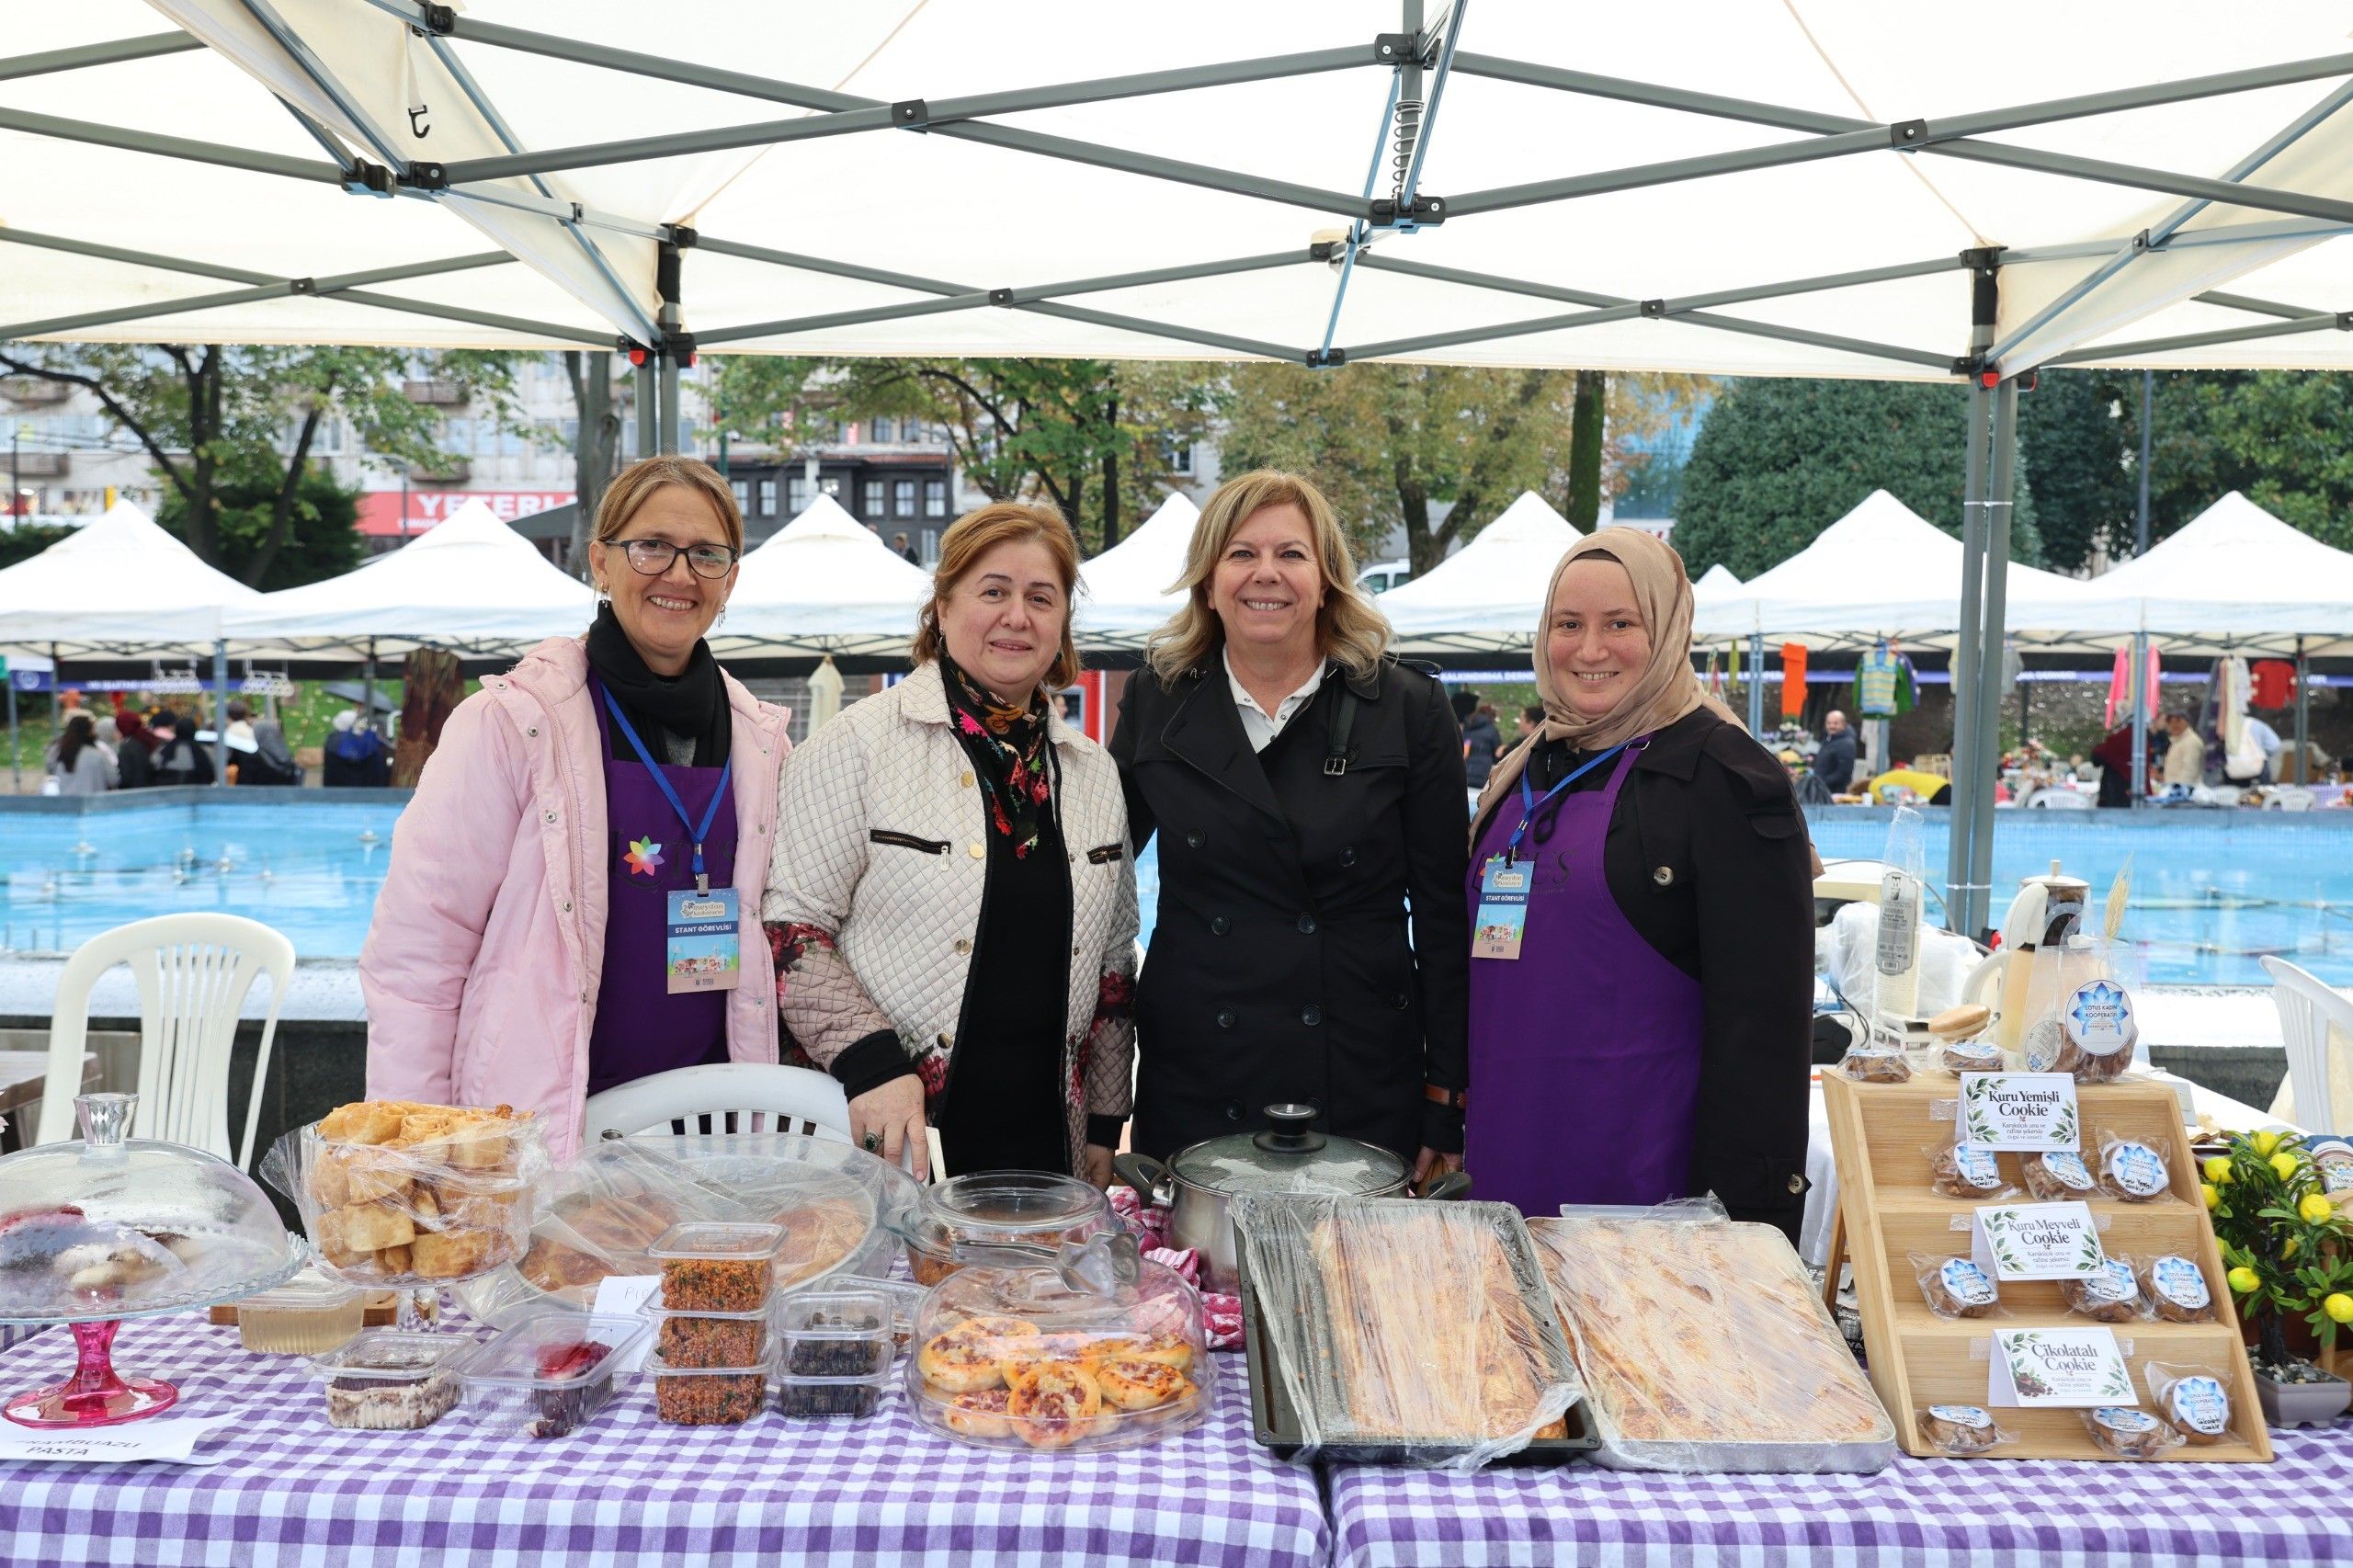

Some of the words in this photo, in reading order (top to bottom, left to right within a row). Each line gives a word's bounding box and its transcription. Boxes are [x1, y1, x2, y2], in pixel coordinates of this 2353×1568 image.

[675, 926, 697, 934] STANT
[698, 924, 732, 932] GÖREVLİSİ
[1989, 1091, 2018, 1102] Kuru
[2018, 1091, 2060, 1105] Yemişli
[1999, 1102, 2048, 1116] Cookie
[2007, 1220, 2035, 1232] Kuru
[2035, 1218, 2081, 1232] Meyveli
[2022, 1231, 2070, 1245] Cookie
[2031, 1344, 2098, 1360] Çikolatalı
[2045, 1358, 2096, 1371] Cookie
[26, 1447, 89, 1455] PASTA
